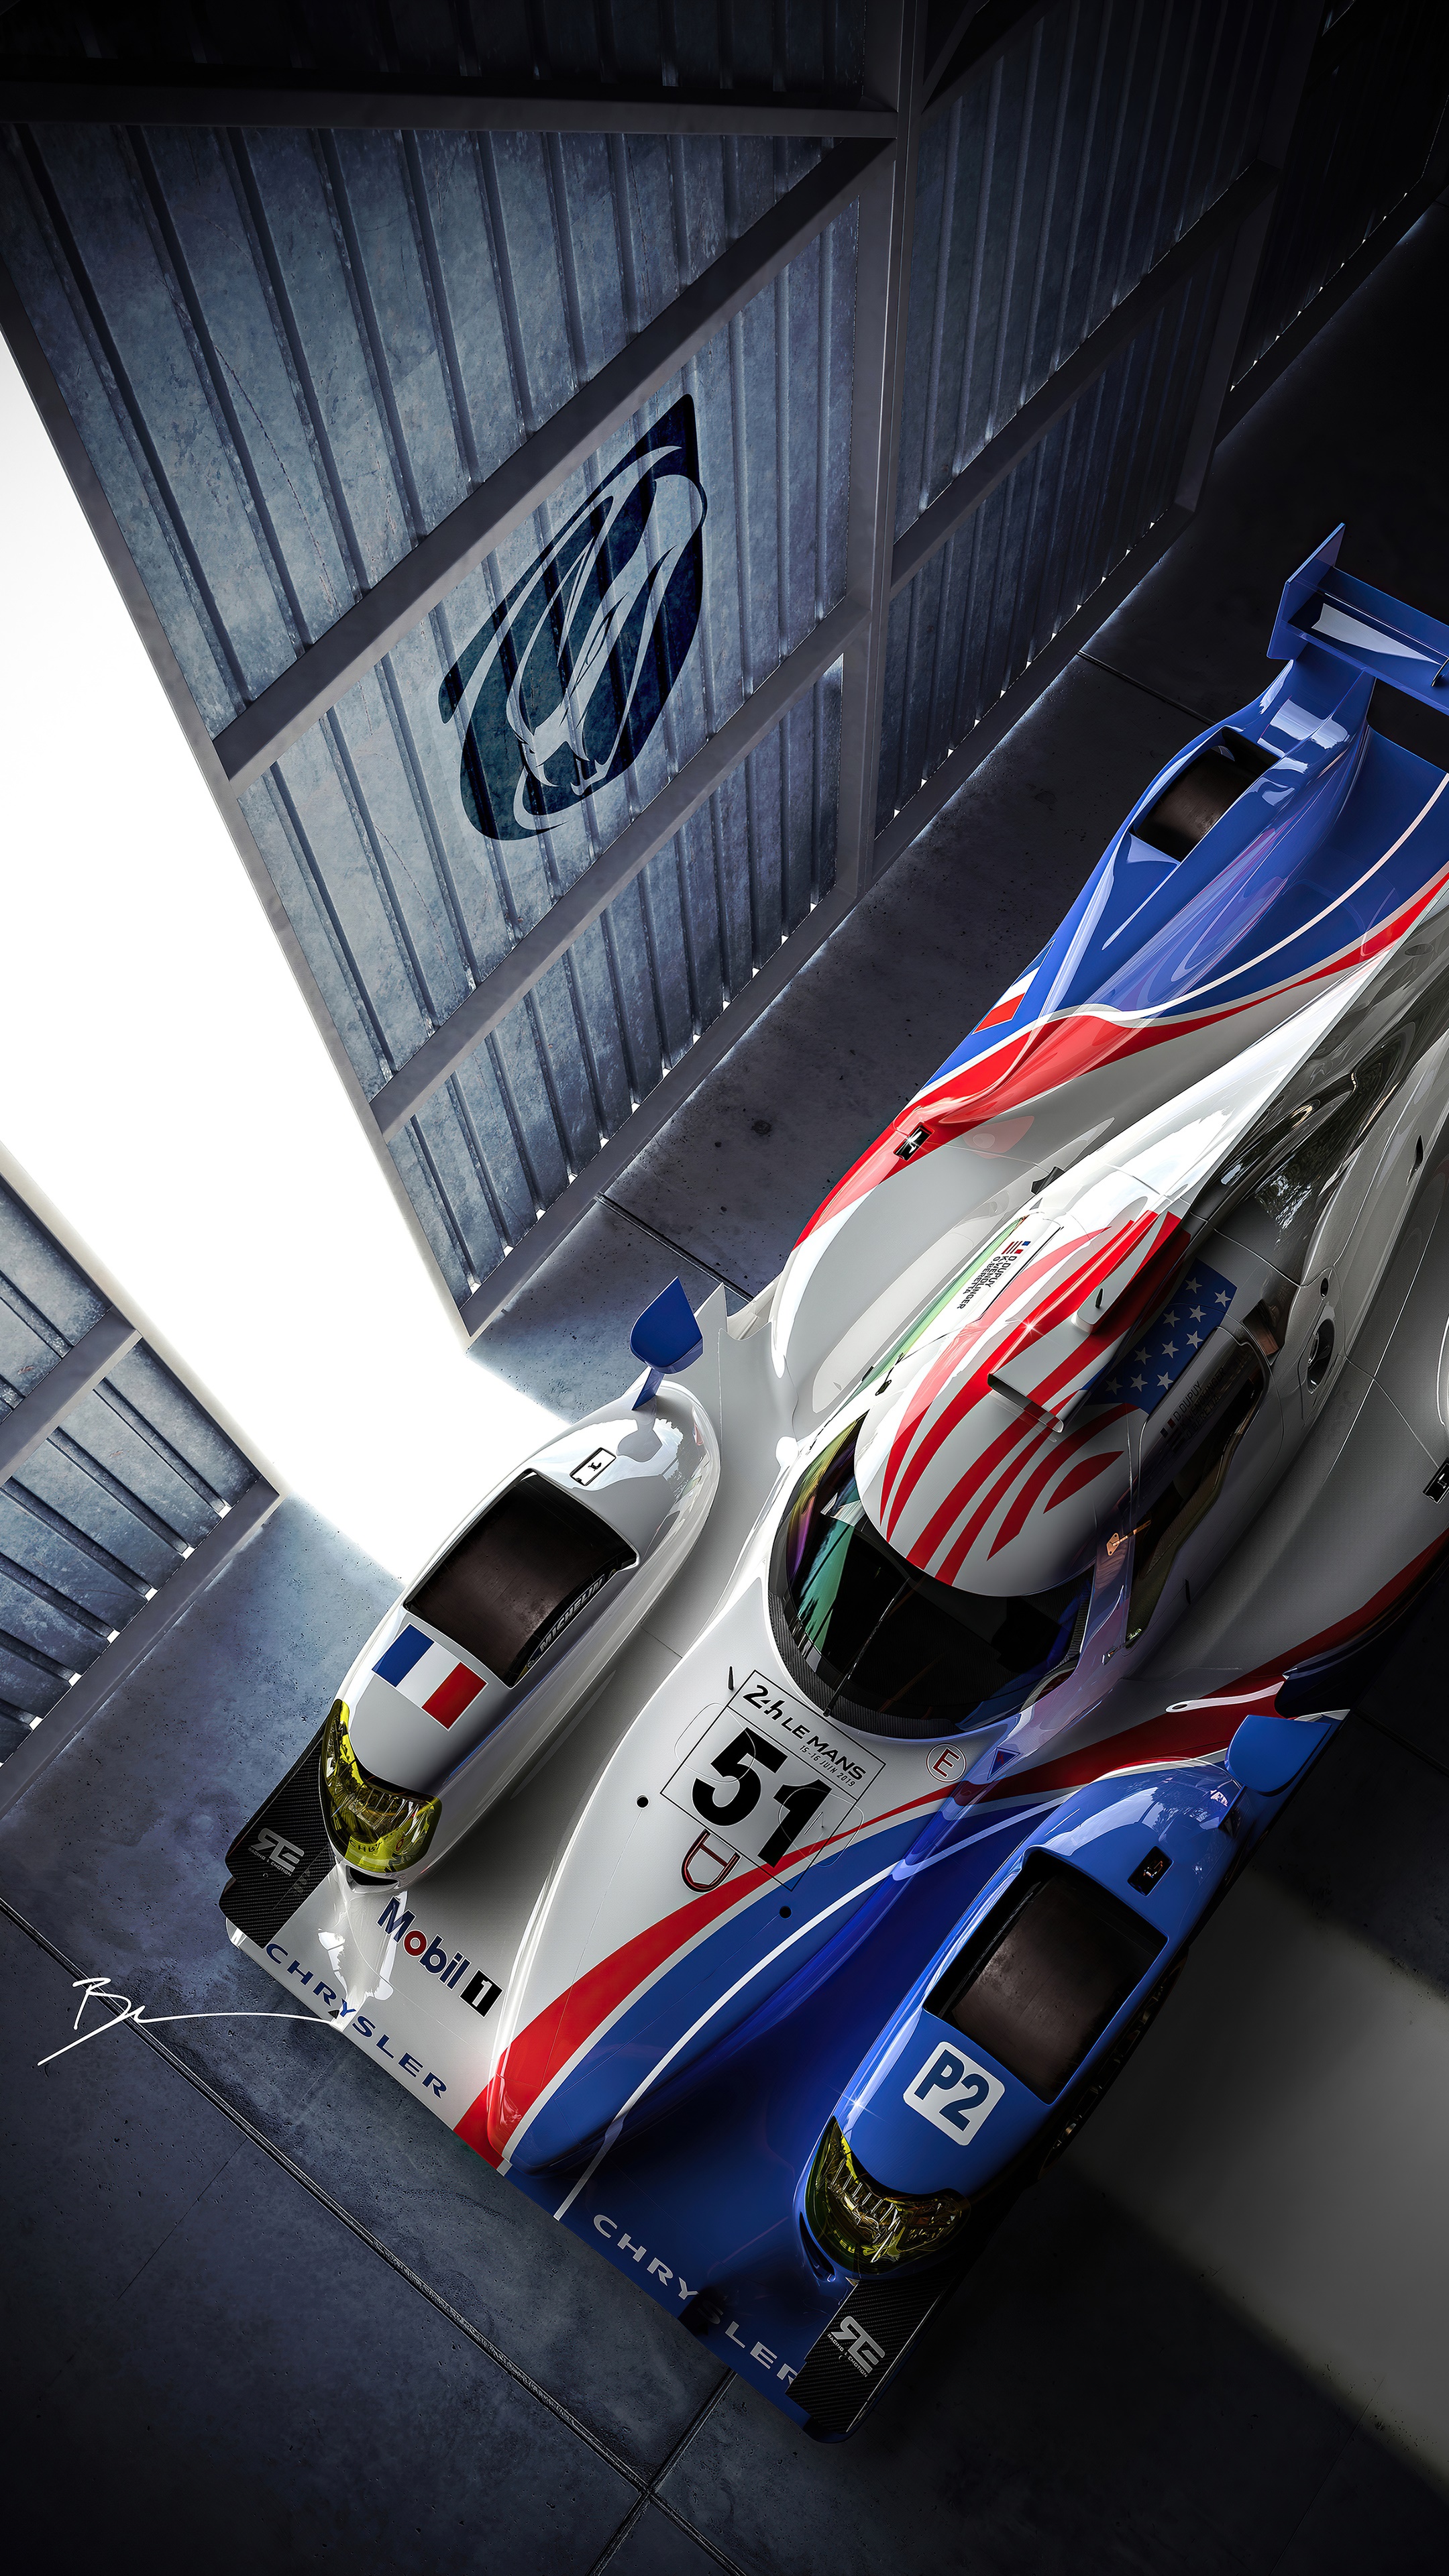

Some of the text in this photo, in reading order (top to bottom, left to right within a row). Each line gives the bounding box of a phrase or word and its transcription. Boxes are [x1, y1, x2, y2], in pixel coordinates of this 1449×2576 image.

[985, 1256, 1018, 1287] D.DUPUY
[539, 1578, 603, 1652] MICHELIN
[781, 1717, 811, 1740] LE
[806, 1735, 867, 1781] MANS
[799, 1744, 856, 1787] 15-16 JUIN 2019
[931, 1748, 961, 1778] E
[692, 1726, 833, 1869] 51
[248, 1847, 266, 1861] RACING
[270, 1861, 292, 1876] EMOTION
[376, 1896, 472, 1990] Mobil
[265, 1943, 449, 2099] CHRYSLER
[913, 2048, 990, 2132] P2
[827, 2333, 844, 2352] RACING
[848, 2356, 868, 2377] EMOTION
